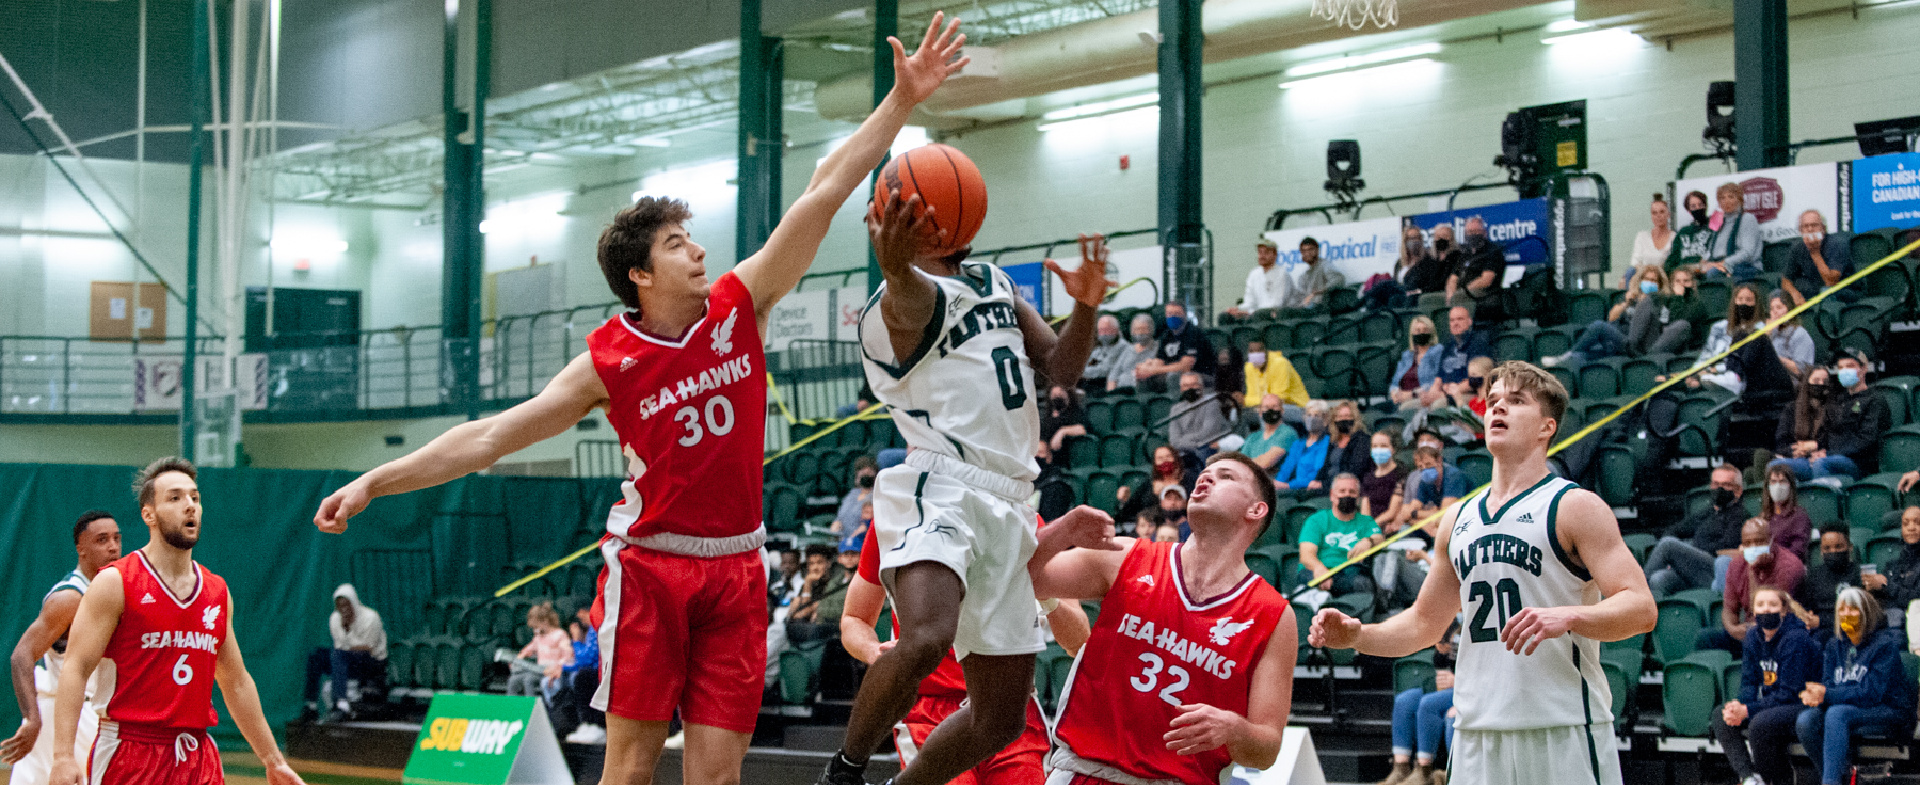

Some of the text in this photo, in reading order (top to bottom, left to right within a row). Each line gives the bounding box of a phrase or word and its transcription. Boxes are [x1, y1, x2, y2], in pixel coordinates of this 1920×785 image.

[1872, 169, 1920, 187] FOR HIGH-
[1318, 234, 1377, 261] Optical
[1489, 219, 1537, 242] centre
[991, 345, 1027, 411] 0
[674, 395, 735, 447] 30
[1468, 578, 1523, 643] 20
[172, 654, 193, 686] 6
[1130, 652, 1190, 706] 32
[420, 717, 523, 755] SUBWAY
